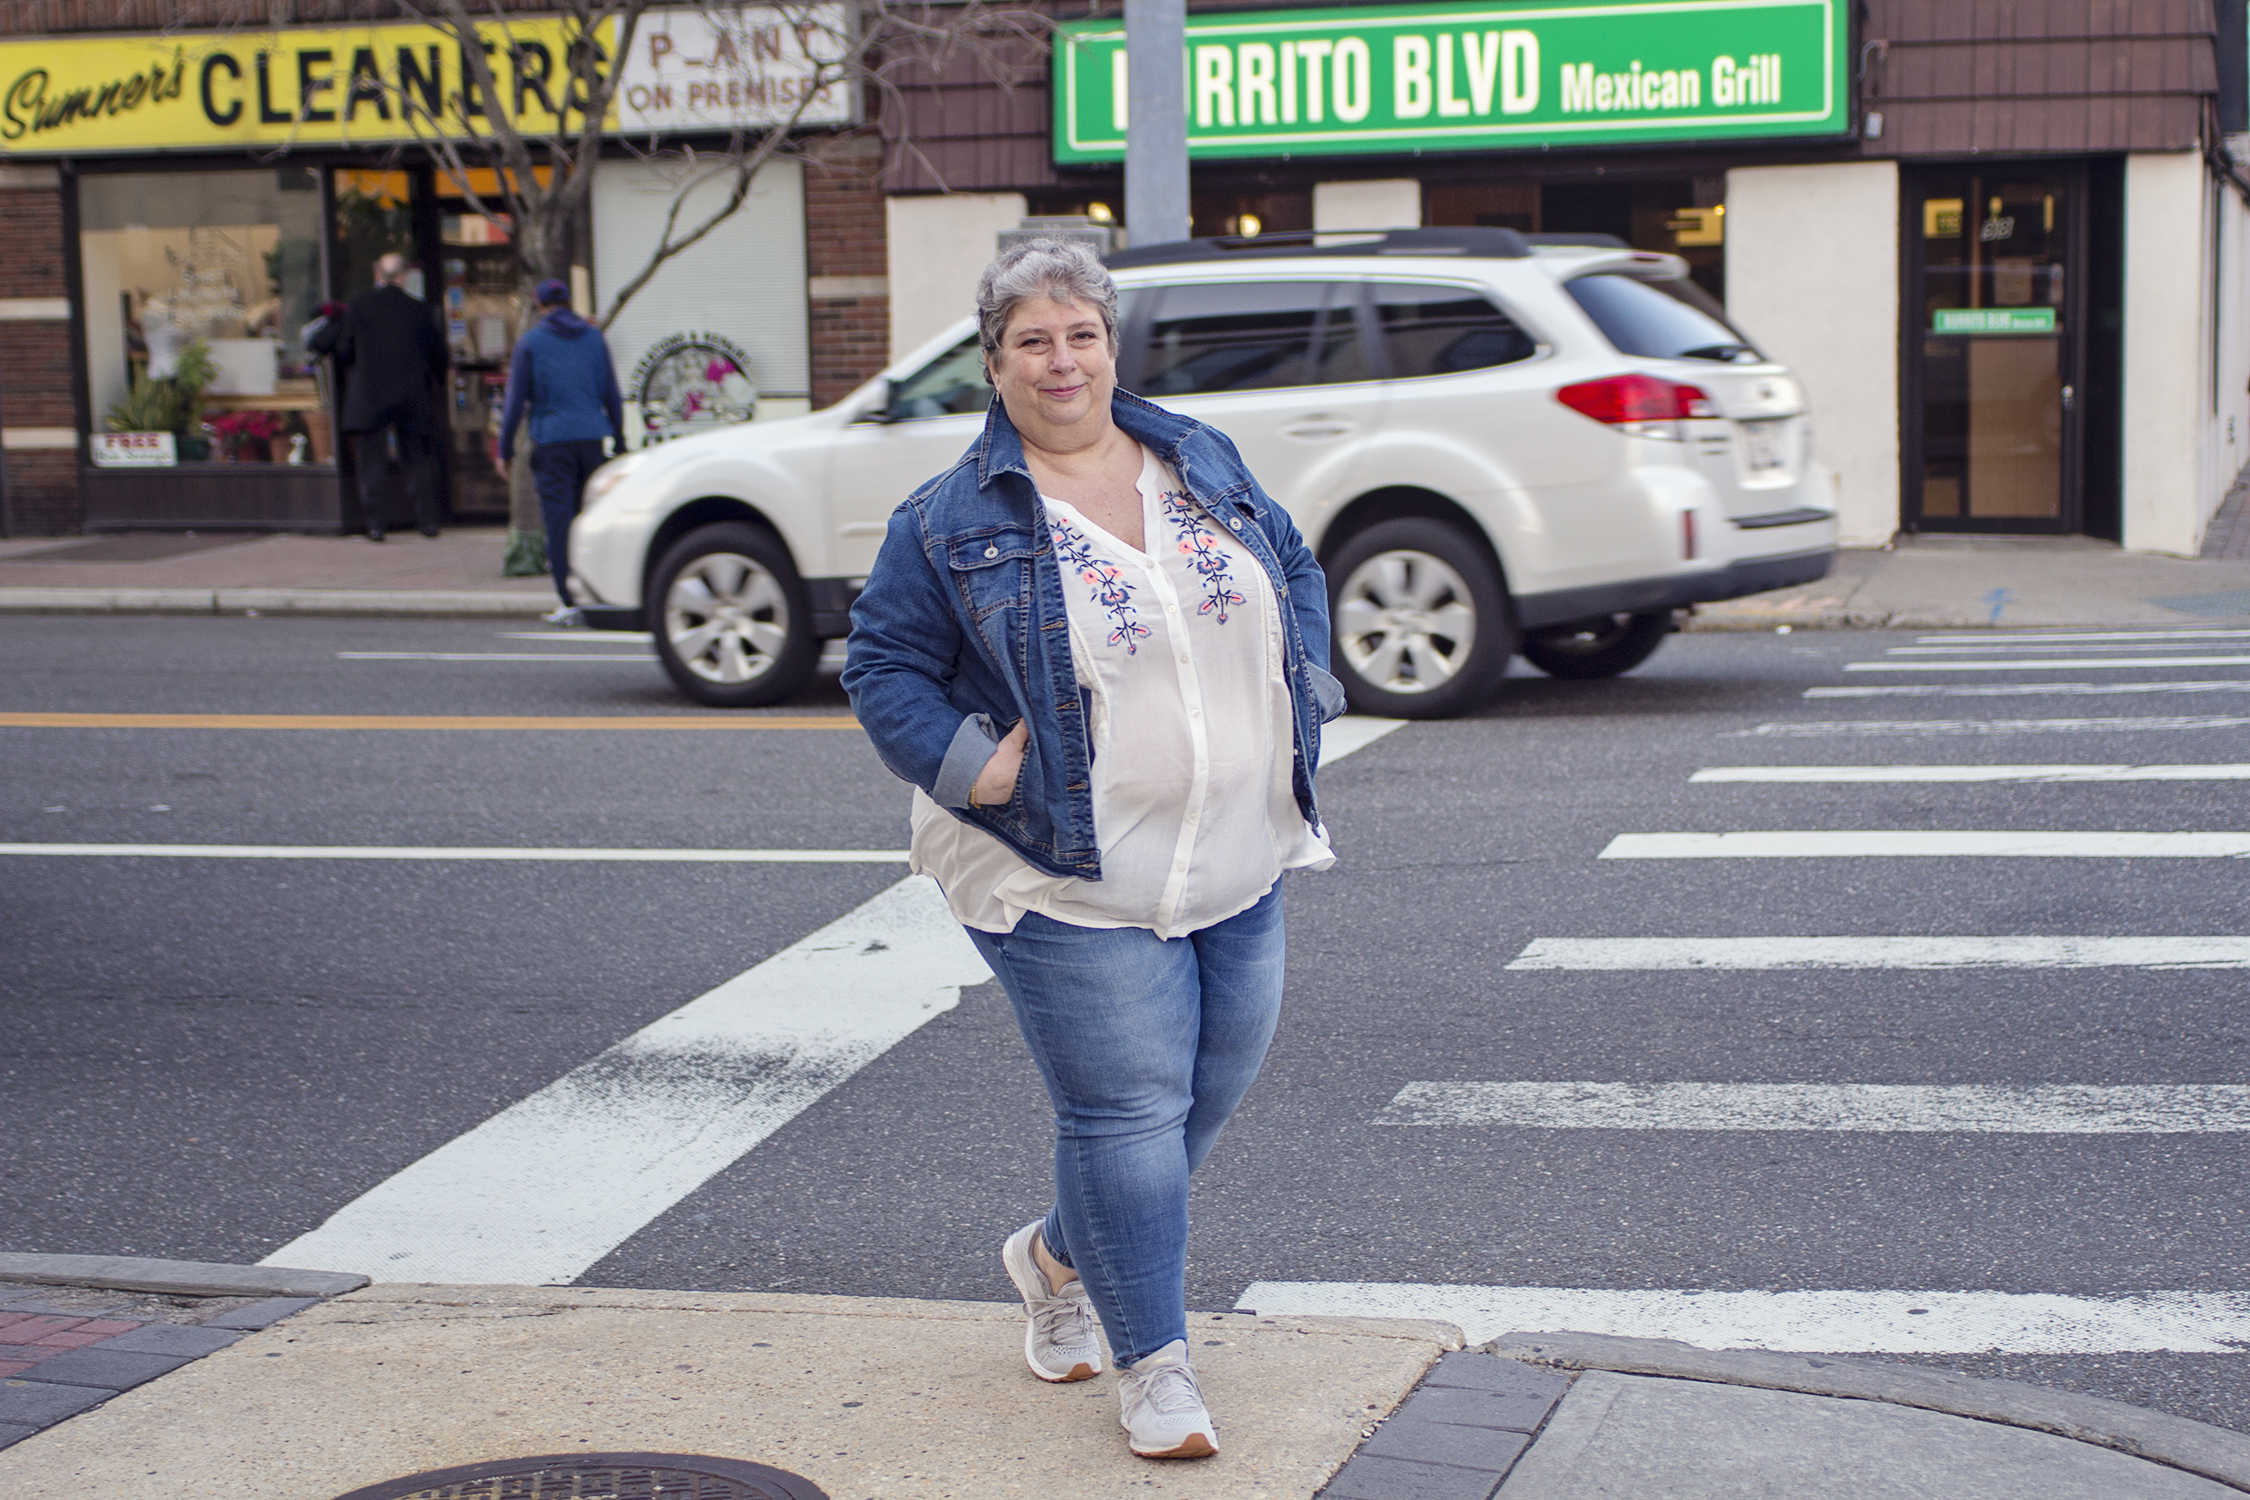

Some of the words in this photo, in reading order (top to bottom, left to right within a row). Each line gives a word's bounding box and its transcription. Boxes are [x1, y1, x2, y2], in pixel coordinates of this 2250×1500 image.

[627, 84, 671, 111] ON
[688, 76, 832, 107] PREMISES
[1112, 36, 1371, 131] RRITO
[1394, 30, 1540, 119] BLVD
[1561, 59, 1700, 113] Mexican
[1711, 53, 1781, 107] Grill
[627, 331, 684, 400] ALTERATIONS
[703, 330, 752, 366] REPAIRS
[104, 433, 159, 449] FREE
